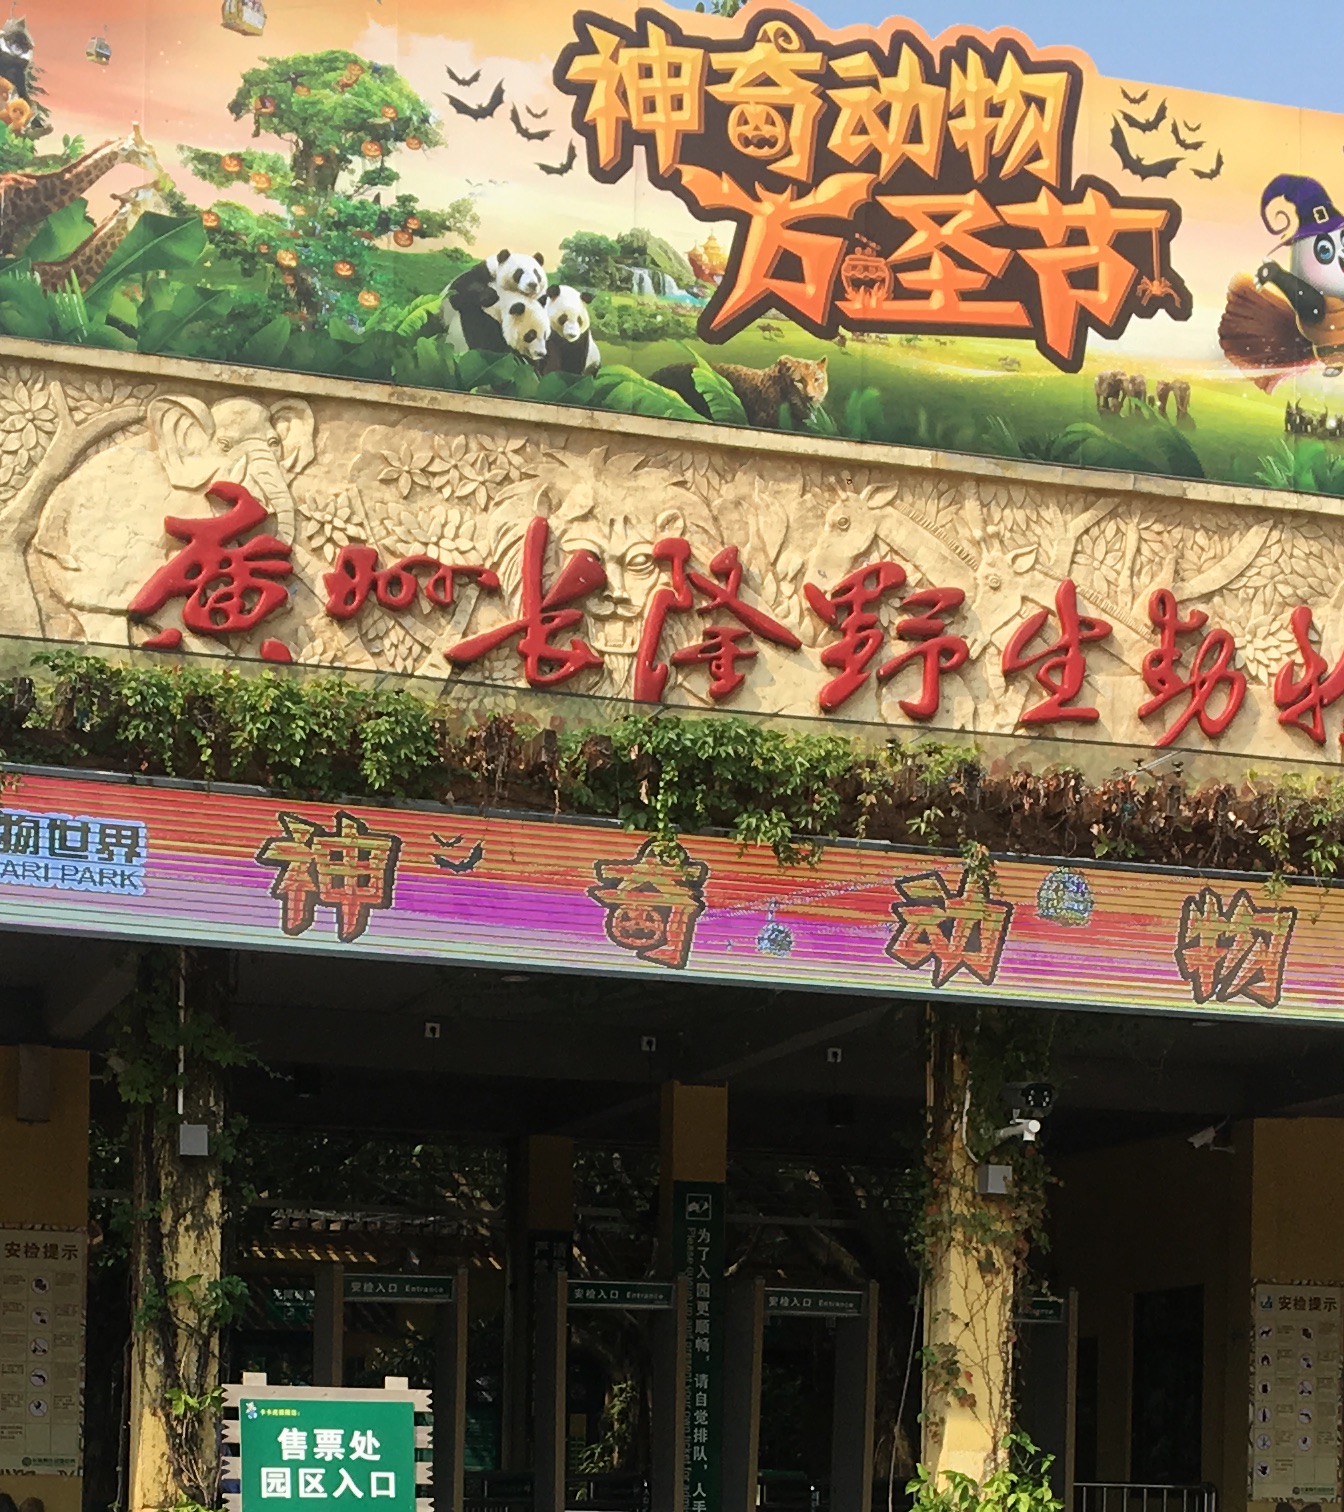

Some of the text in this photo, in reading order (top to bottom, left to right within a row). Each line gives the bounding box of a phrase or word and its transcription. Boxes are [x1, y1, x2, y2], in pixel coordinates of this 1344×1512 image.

[566, 19, 1071, 185] 神奇动物
[677, 163, 1170, 362] 万圣节
[61, 863, 139, 889] PARK
[4, 1241, 79, 1261] 安检提示
[687, 1227, 697, 1264] Please
[350, 1281, 445, 1294] 安检入口 Entrance
[573, 1288, 664, 1300] 安检入口 Entrance
[768, 1296, 855, 1308] 安检入口 Entrance
[1278, 1295, 1338, 1312] 安检提示
[277, 1428, 381, 1461] 售票处
[260, 1467, 396, 1498] 园区入口
